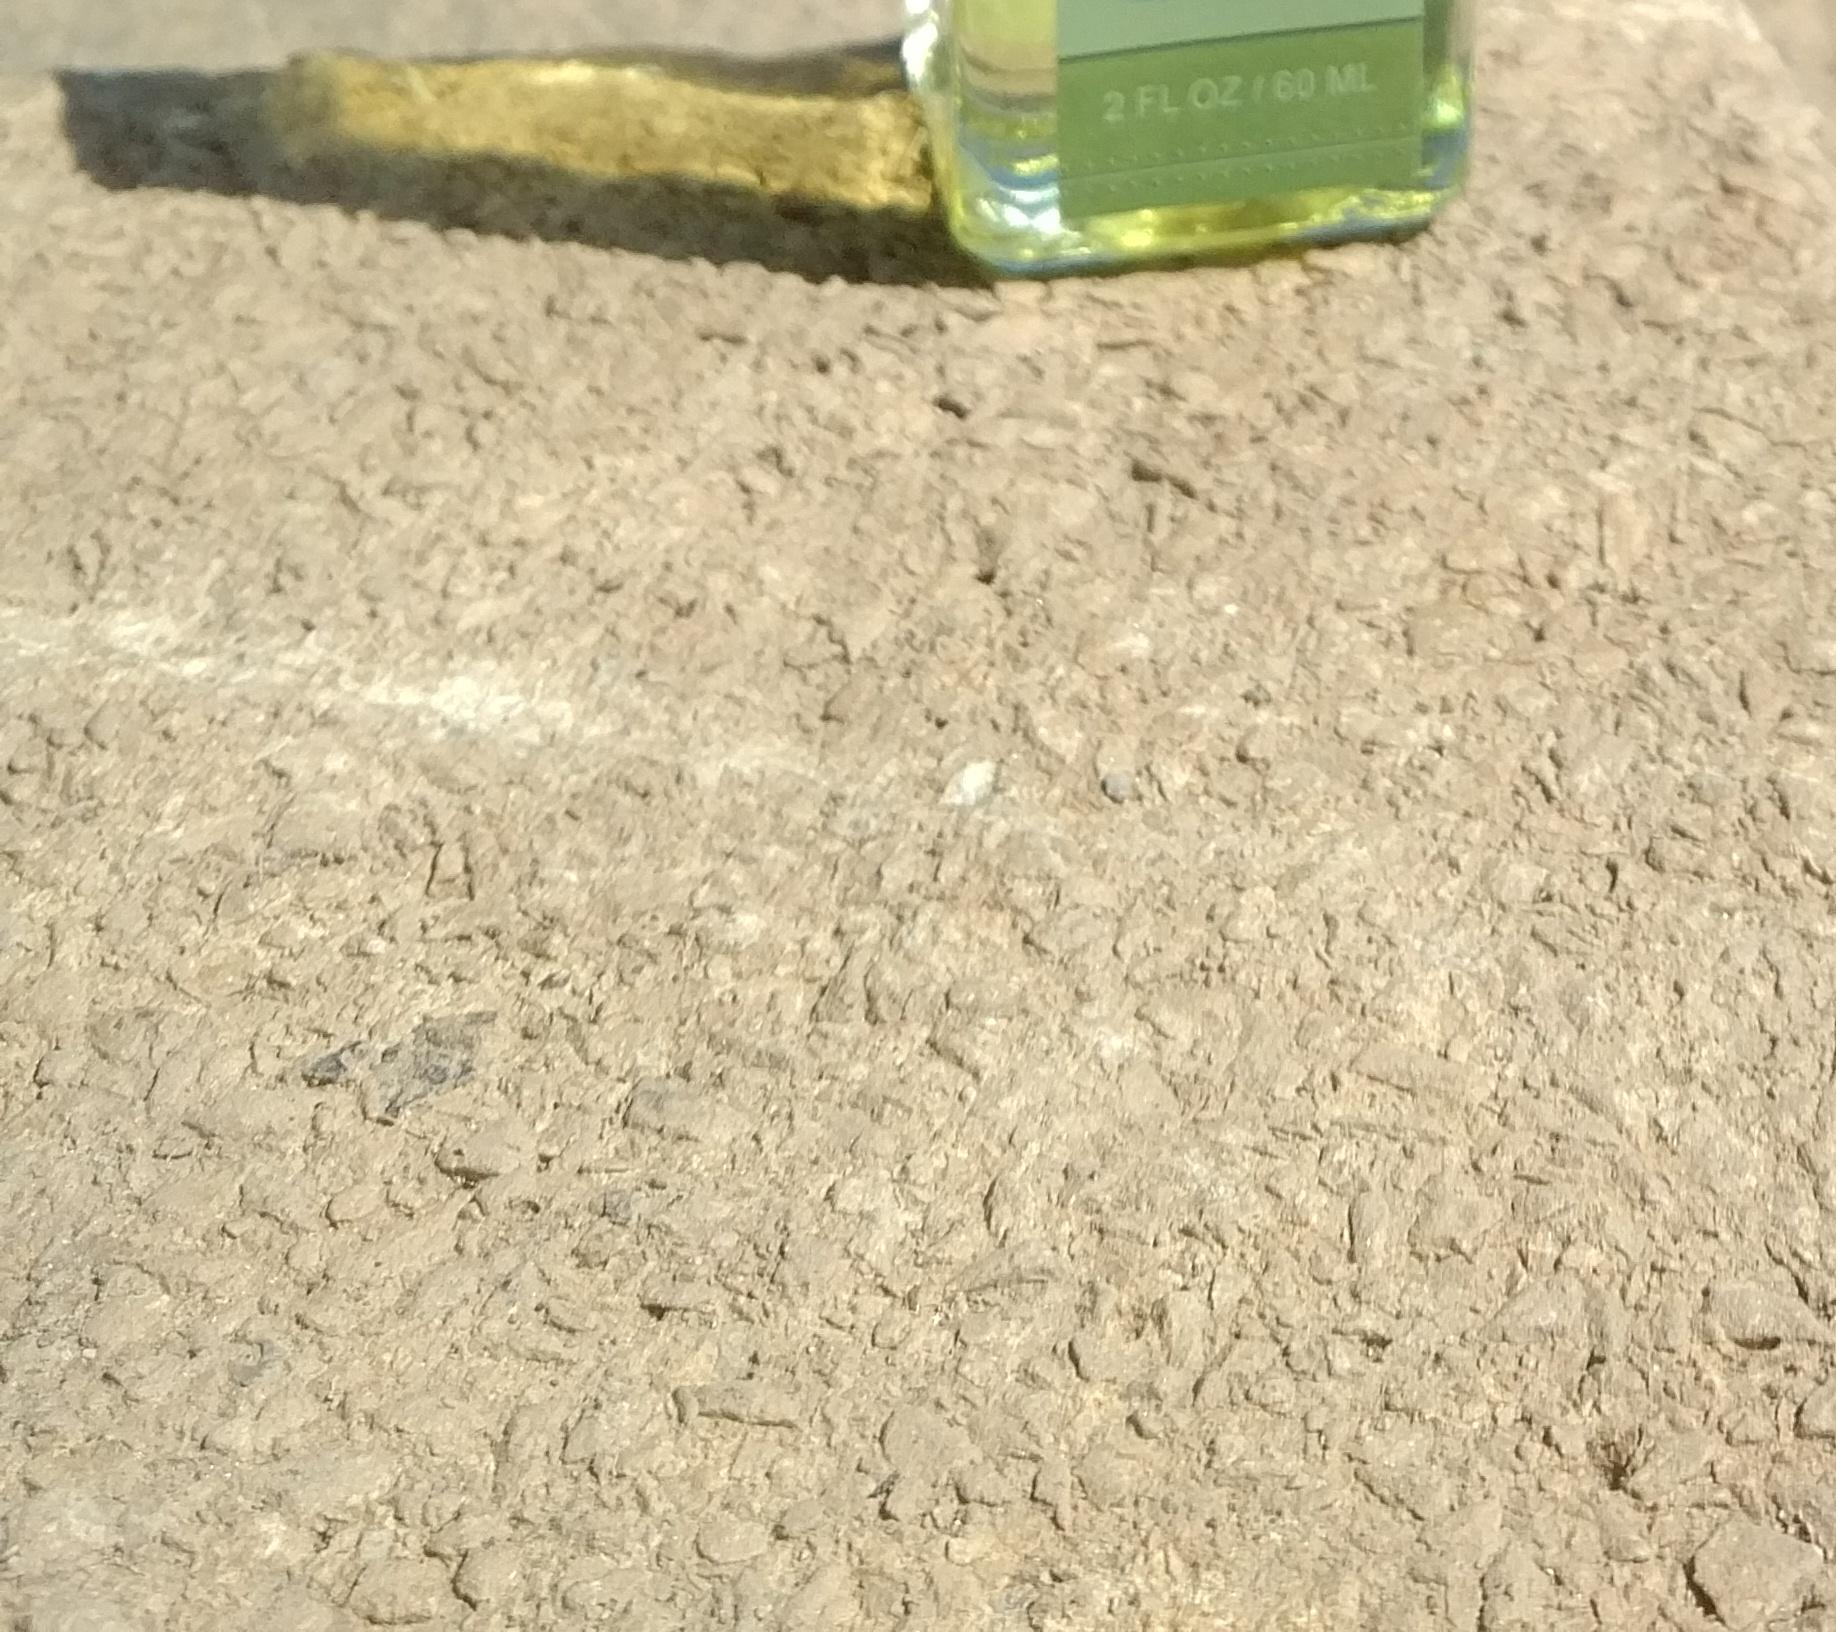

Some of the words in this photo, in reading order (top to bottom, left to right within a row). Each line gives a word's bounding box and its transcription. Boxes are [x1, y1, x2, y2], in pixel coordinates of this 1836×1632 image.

[1102, 90, 1126, 122] 2
[1136, 84, 1180, 119] FL
[1187, 75, 1243, 110] OZ
[1325, 62, 1378, 95] ML
